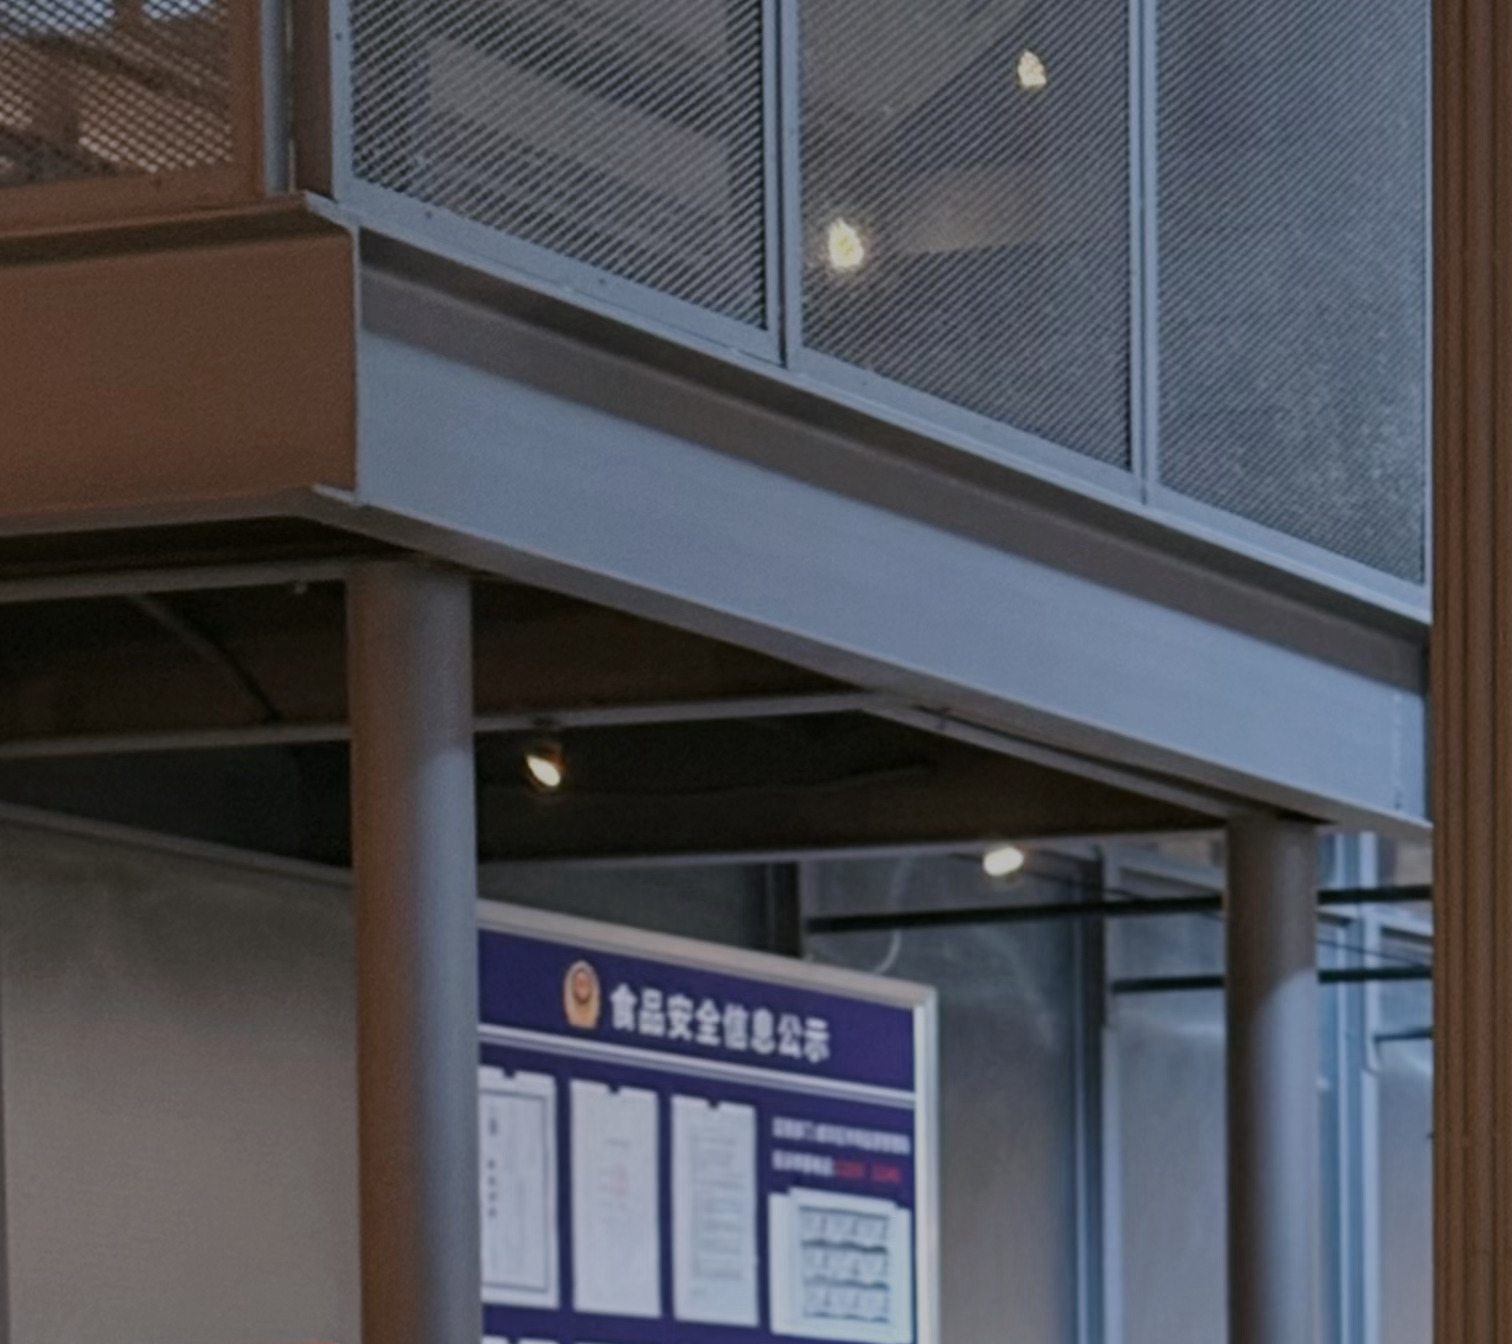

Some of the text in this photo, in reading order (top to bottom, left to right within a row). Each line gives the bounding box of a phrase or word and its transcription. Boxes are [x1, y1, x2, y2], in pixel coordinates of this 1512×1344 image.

[610, 983, 830, 1063] 食品安全信息公示
